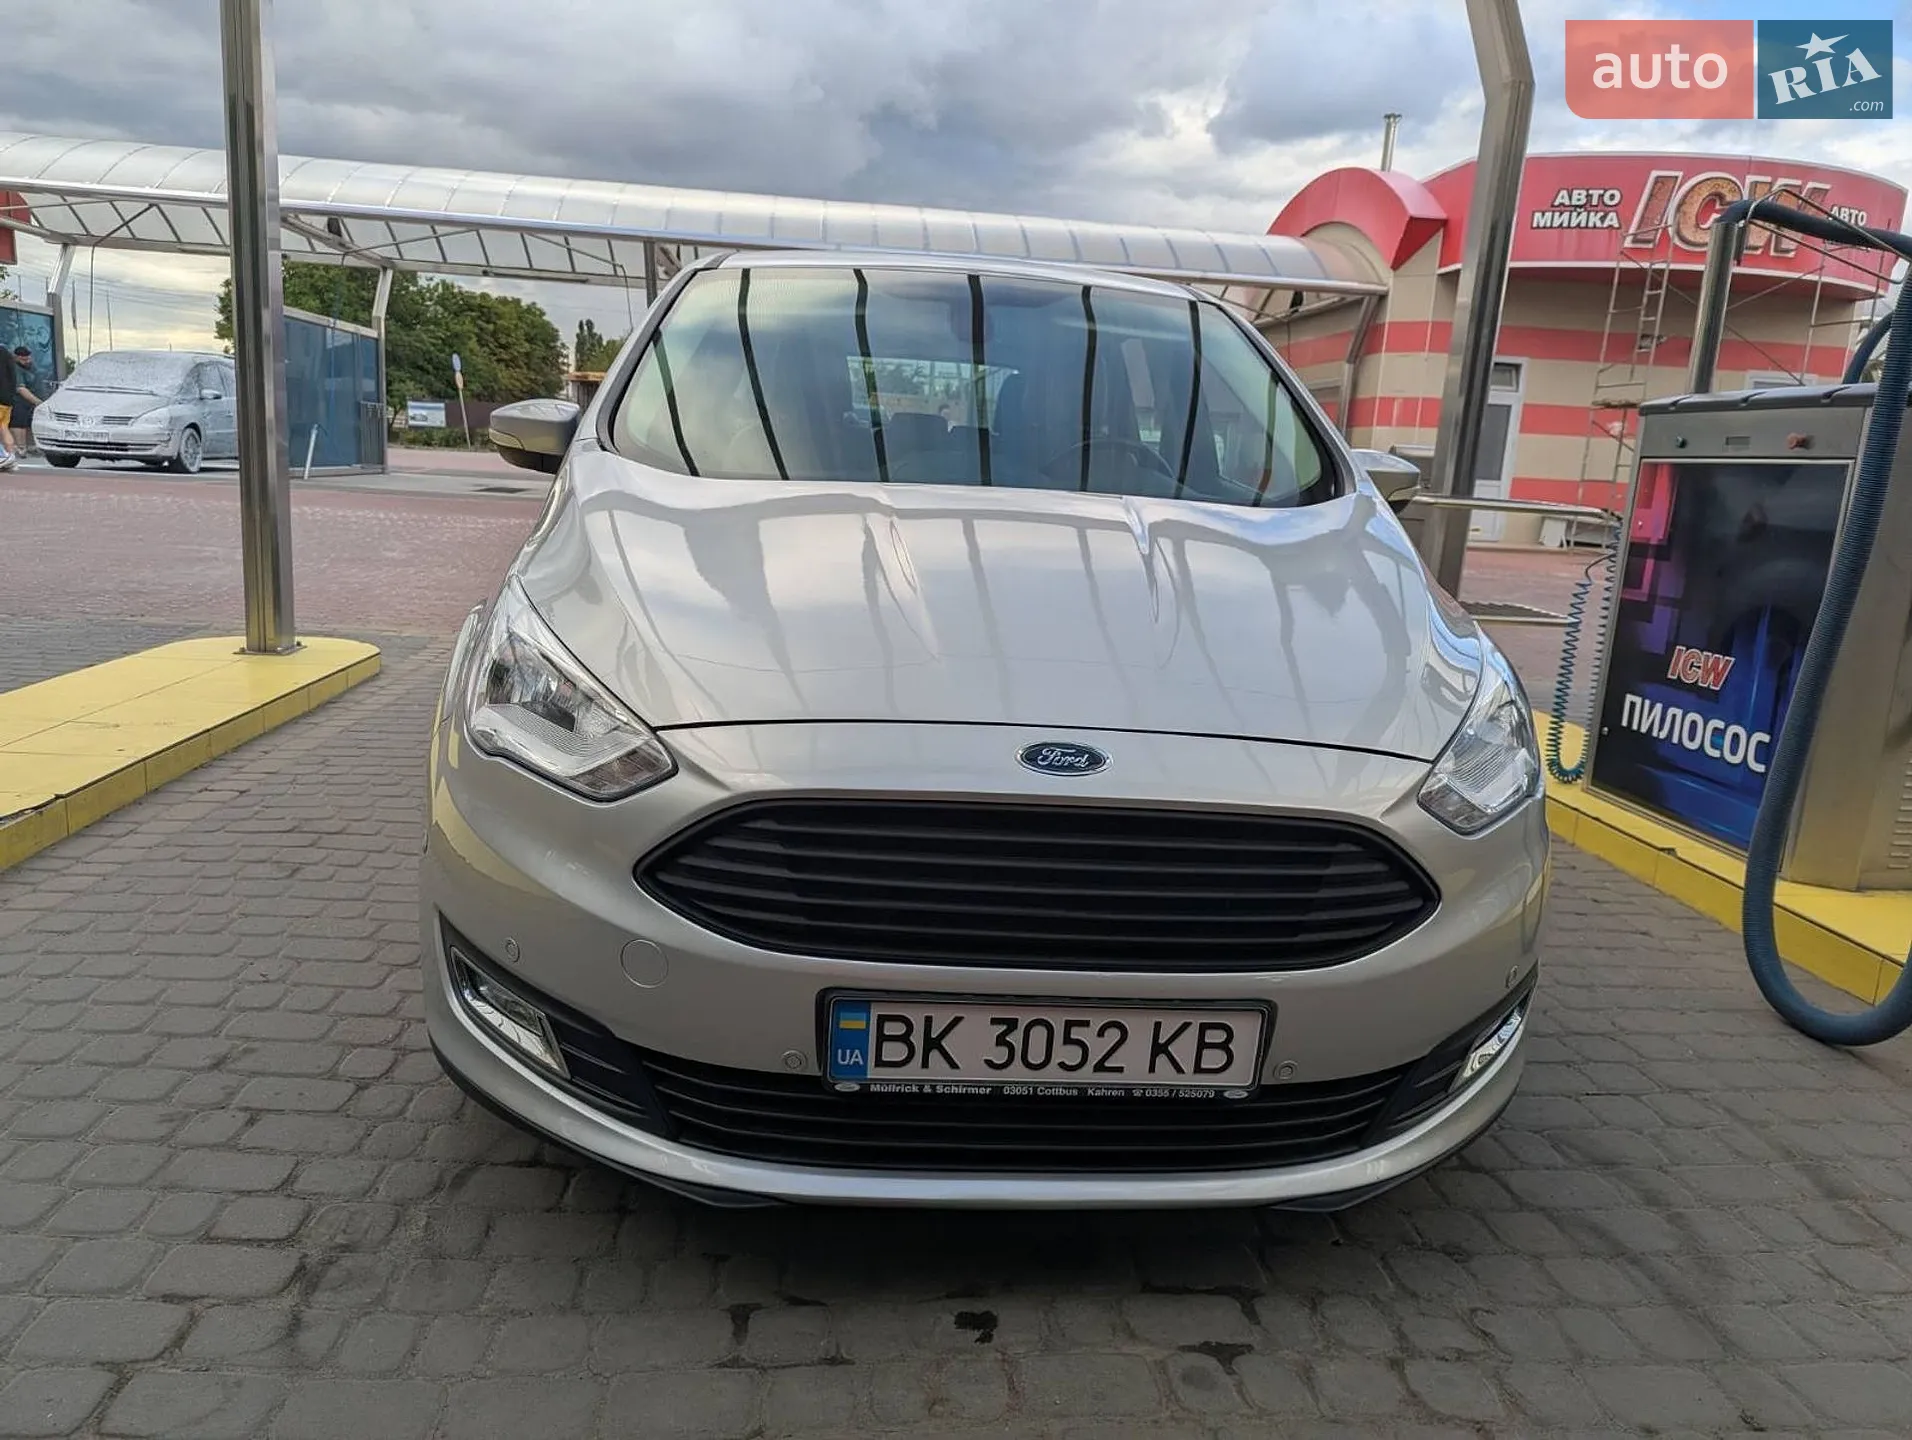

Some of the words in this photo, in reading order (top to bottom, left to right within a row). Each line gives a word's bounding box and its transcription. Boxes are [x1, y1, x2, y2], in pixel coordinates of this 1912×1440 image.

[1553, 188, 1622, 208] АВТО
[1531, 206, 1621, 229] МИЙКА
[1623, 170, 1832, 258] ICW
[1830, 206, 1868, 227] АВТО
[1667, 645, 1735, 690] ICW
[1621, 693, 1771, 773] ПИЛОСОС
[1037, 747, 1089, 768] Ford
[874, 1013, 965, 1070] BK
[983, 1017, 1129, 1073] 3052
[1148, 1021, 1235, 1075] KB
[837, 1048, 864, 1066] UA
[922, 1084, 932, 1094] &
[935, 1084, 993, 1096] Schirmer
[1003, 1085, 1034, 1096] 03051
[1036, 1086, 1079, 1097] Cottbus
[1087, 1087, 1126, 1098] Kahren
